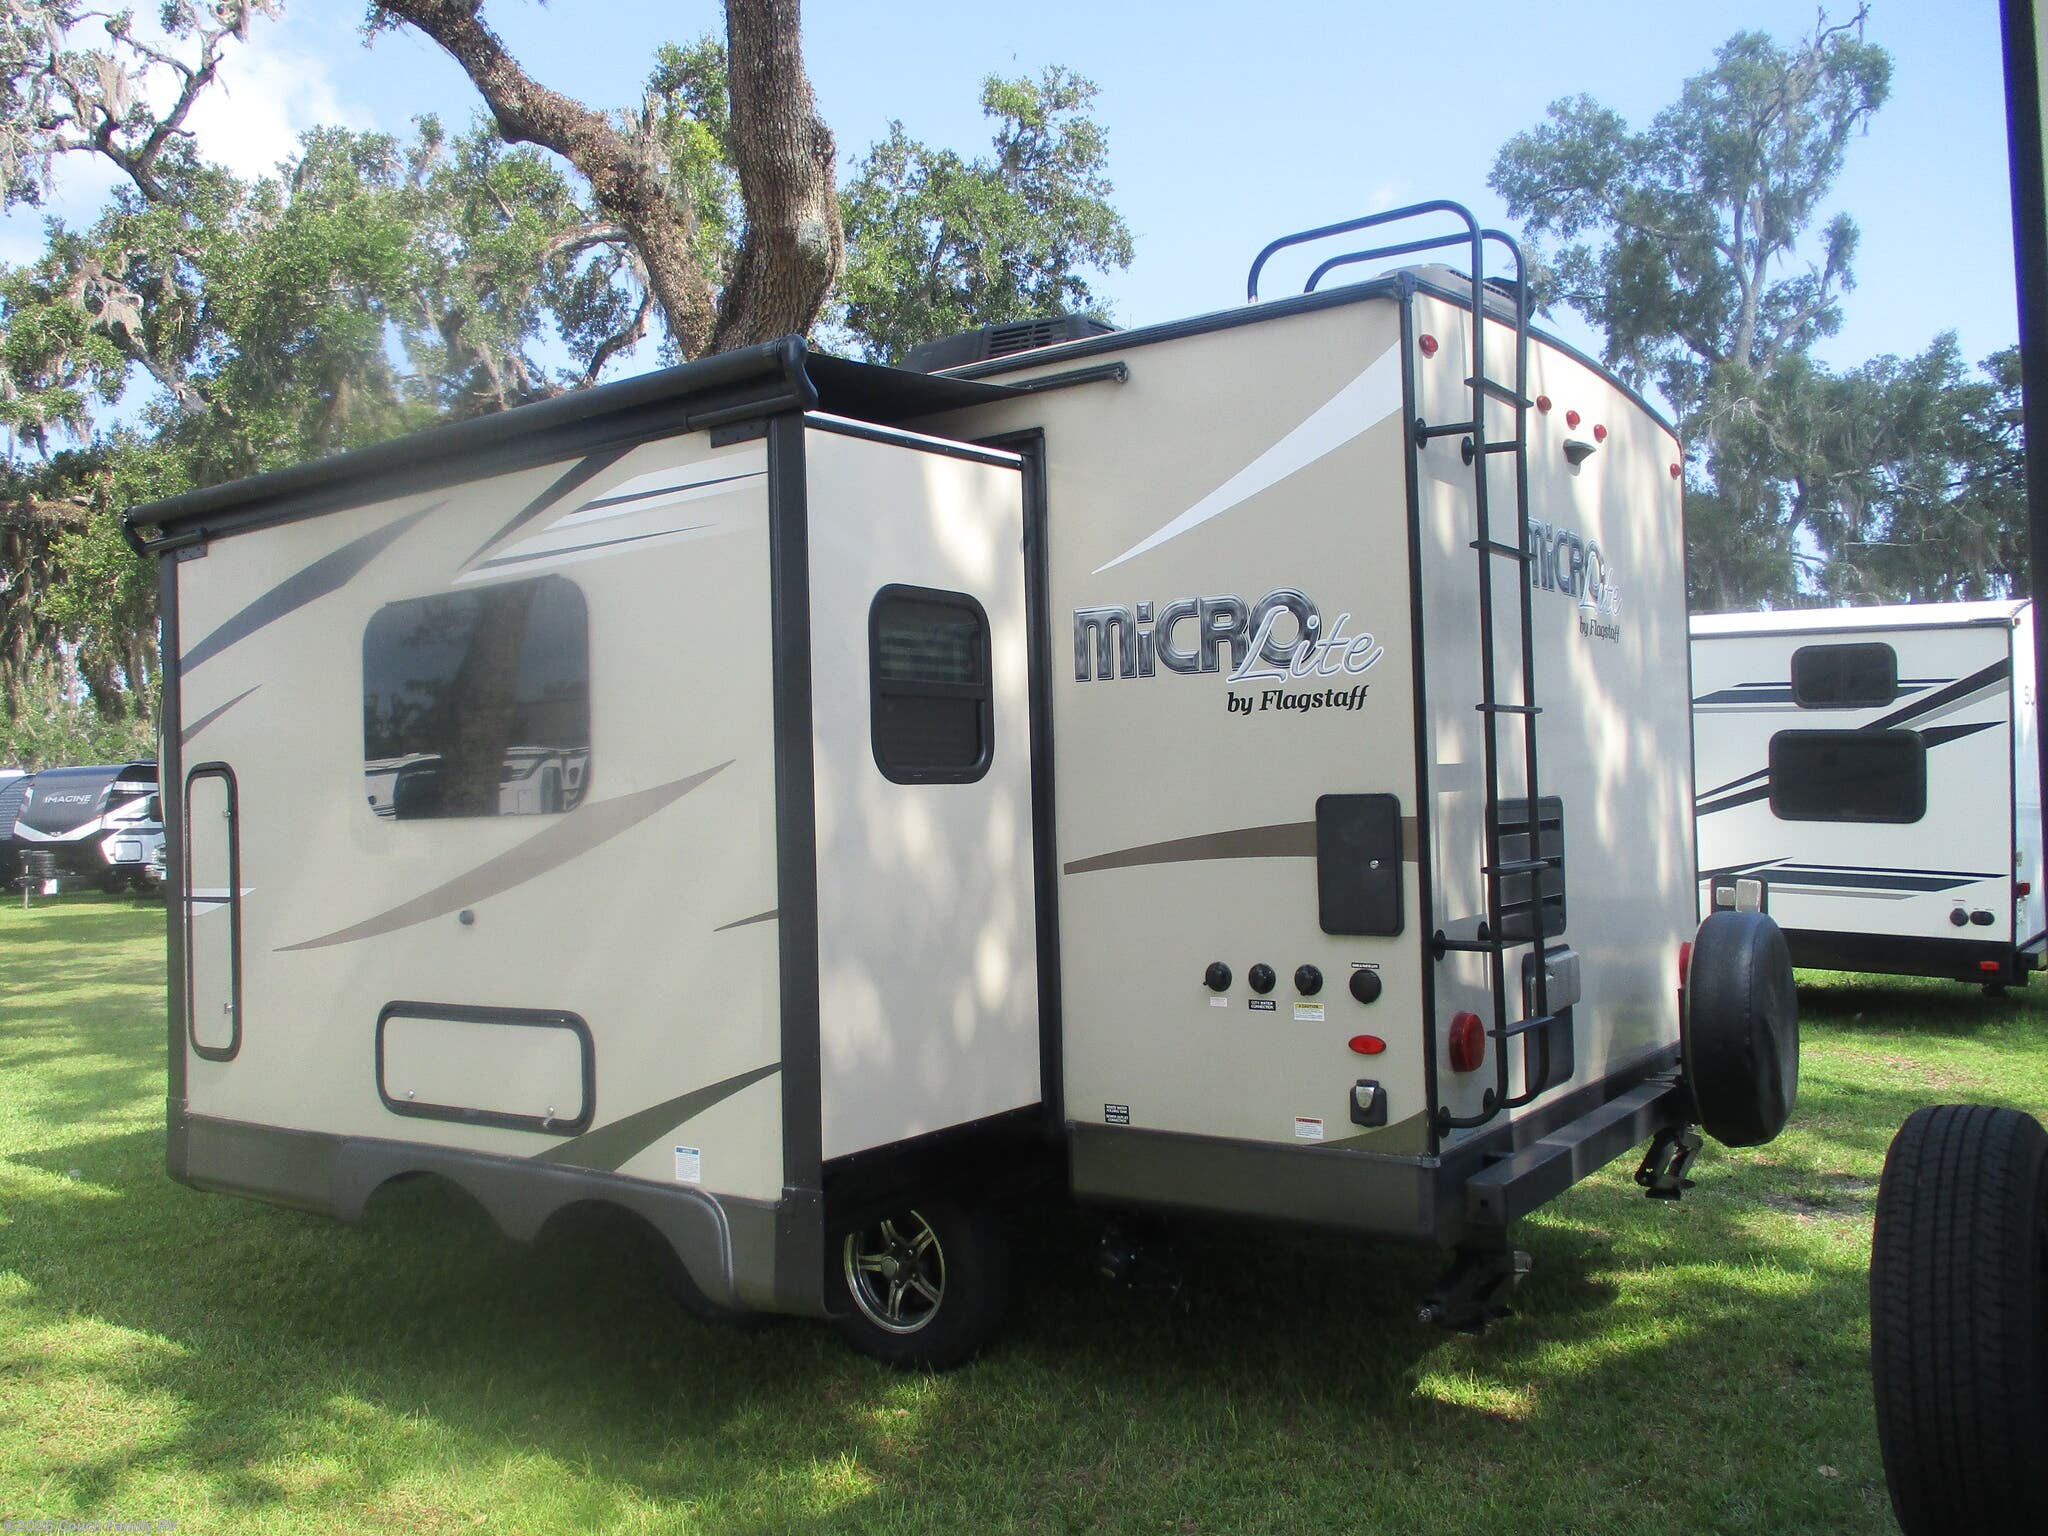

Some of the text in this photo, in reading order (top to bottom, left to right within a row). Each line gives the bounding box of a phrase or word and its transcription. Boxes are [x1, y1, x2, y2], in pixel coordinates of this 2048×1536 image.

[1226, 605, 1384, 683] Lite
[1579, 616, 1620, 643] by Flagstaff
[1227, 685, 1370, 716] by Flagstaff
[44, 794, 93, 803] IMAGINE
